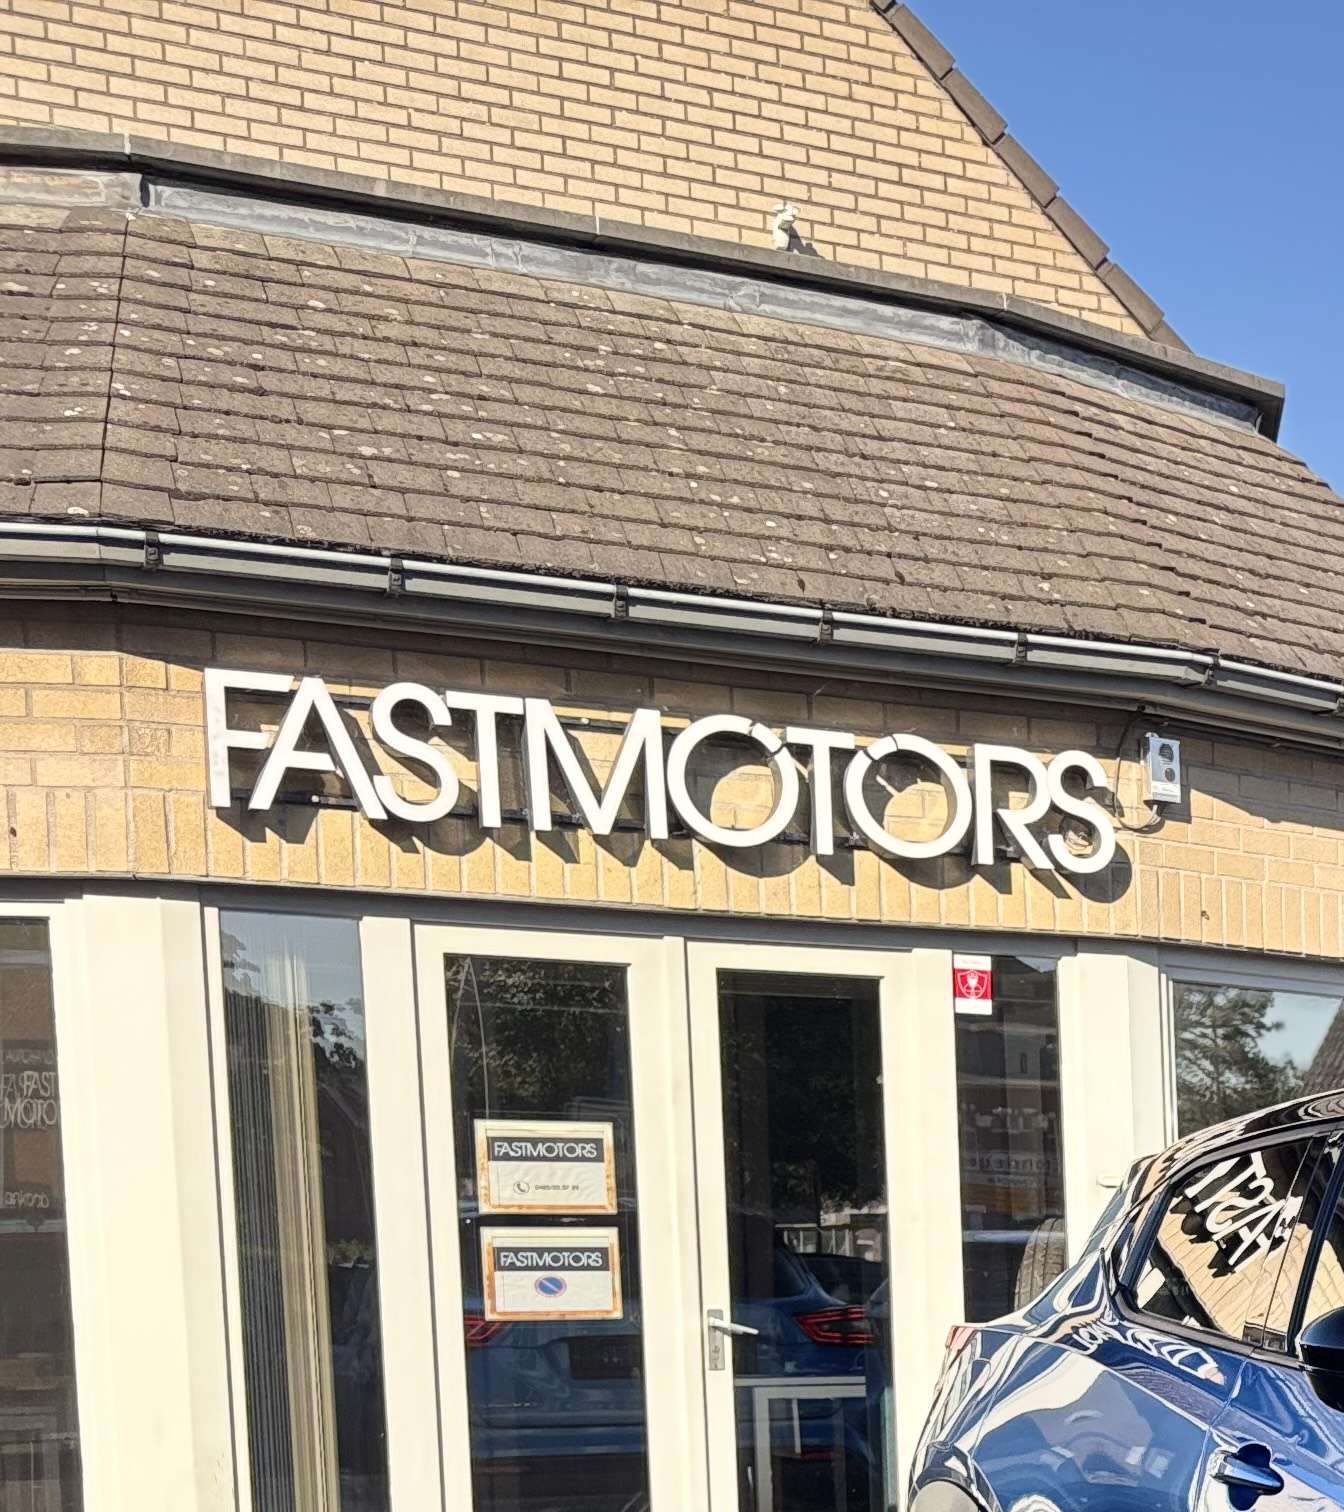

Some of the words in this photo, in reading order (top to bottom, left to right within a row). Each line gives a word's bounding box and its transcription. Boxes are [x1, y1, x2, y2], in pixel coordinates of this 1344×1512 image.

[204, 667, 1118, 875] FASTMOTORS
[494, 1141, 598, 1159] FASTMOTORS
[500, 1251, 602, 1267] FASTMOTORS
